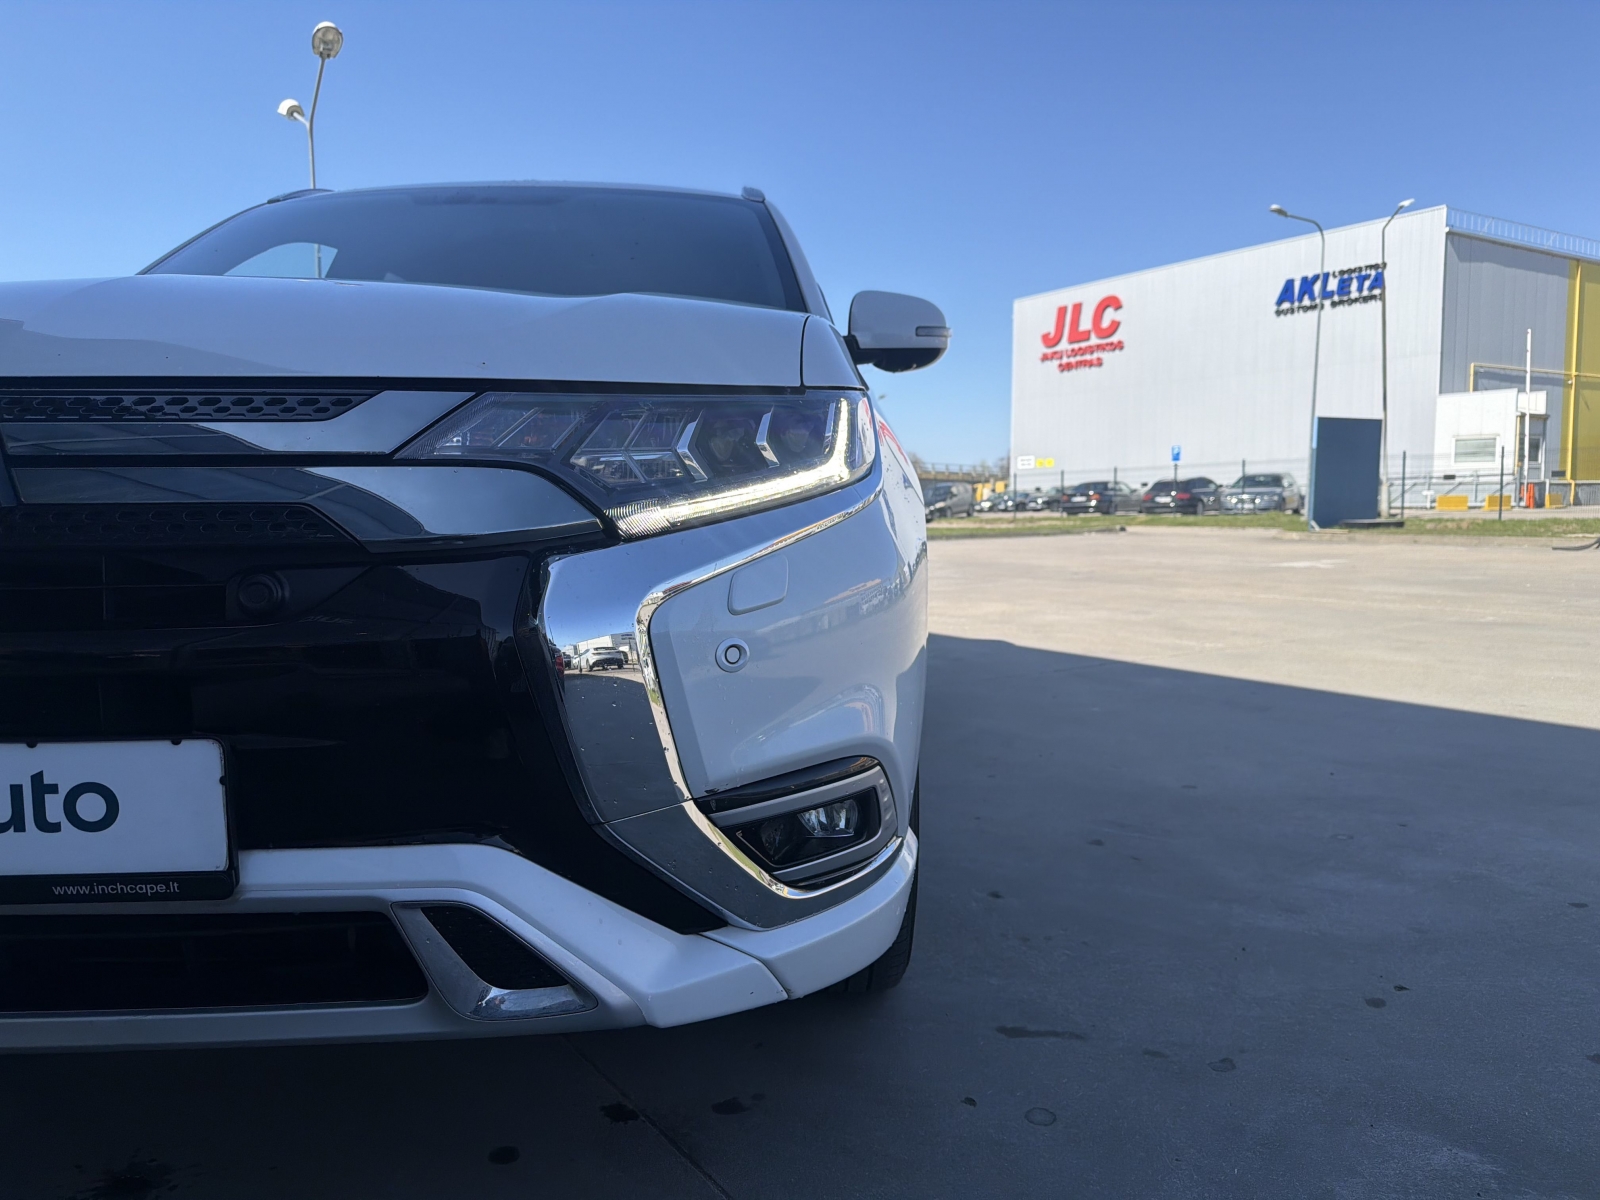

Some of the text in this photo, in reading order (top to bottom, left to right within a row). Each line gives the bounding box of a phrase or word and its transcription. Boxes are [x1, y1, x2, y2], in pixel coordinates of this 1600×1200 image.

[1275, 271, 1385, 307] AKLETA
[1041, 295, 1123, 348] JLC
[52, 882, 180, 896] www.inchcape.lt
